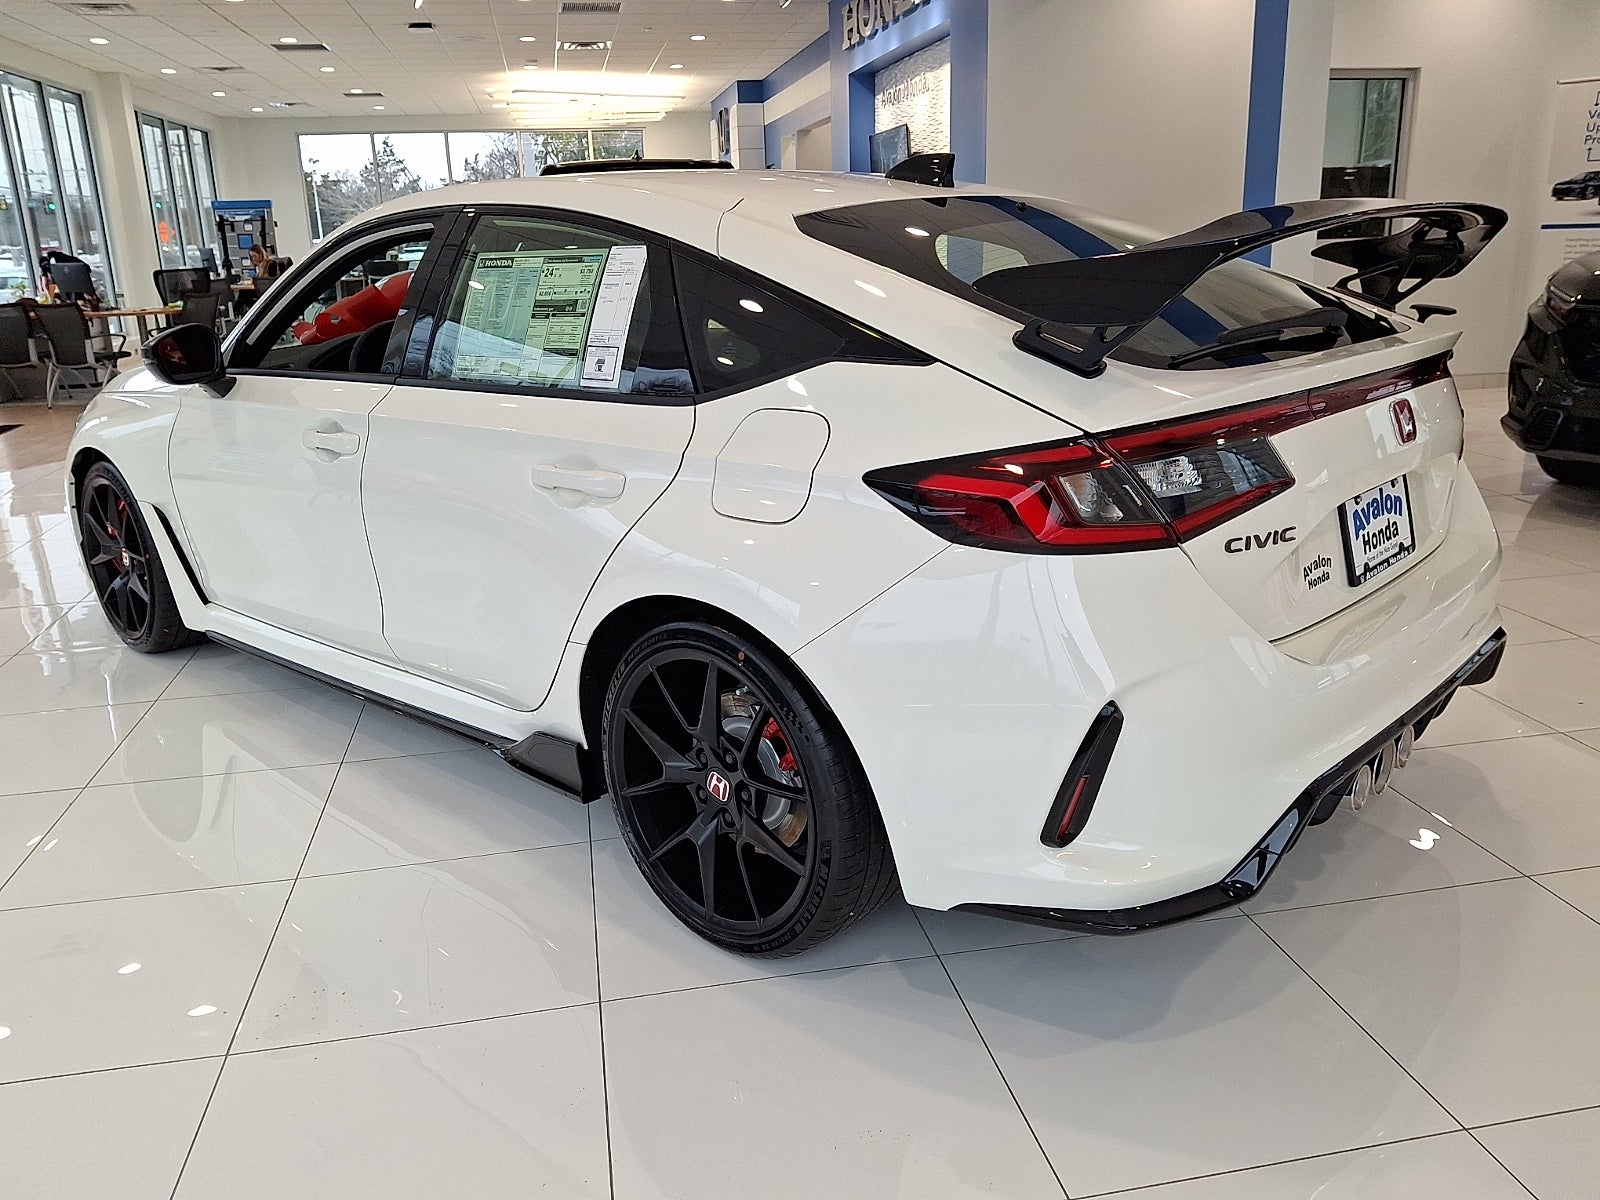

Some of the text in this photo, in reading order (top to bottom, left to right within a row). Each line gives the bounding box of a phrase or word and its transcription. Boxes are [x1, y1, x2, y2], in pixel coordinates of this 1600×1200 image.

[485, 259, 512, 267] HONDA
[544, 268, 554, 278] 24
[1352, 487, 1403, 541] Avalon
[1224, 526, 1297, 554] CIVIC
[1362, 518, 1399, 555] Honda
[1303, 554, 1332, 581] Avalon
[1366, 550, 1409, 580] Avalon Honda
[1307, 570, 1331, 590] Honda
[792, 863, 829, 934] MICHELIN
